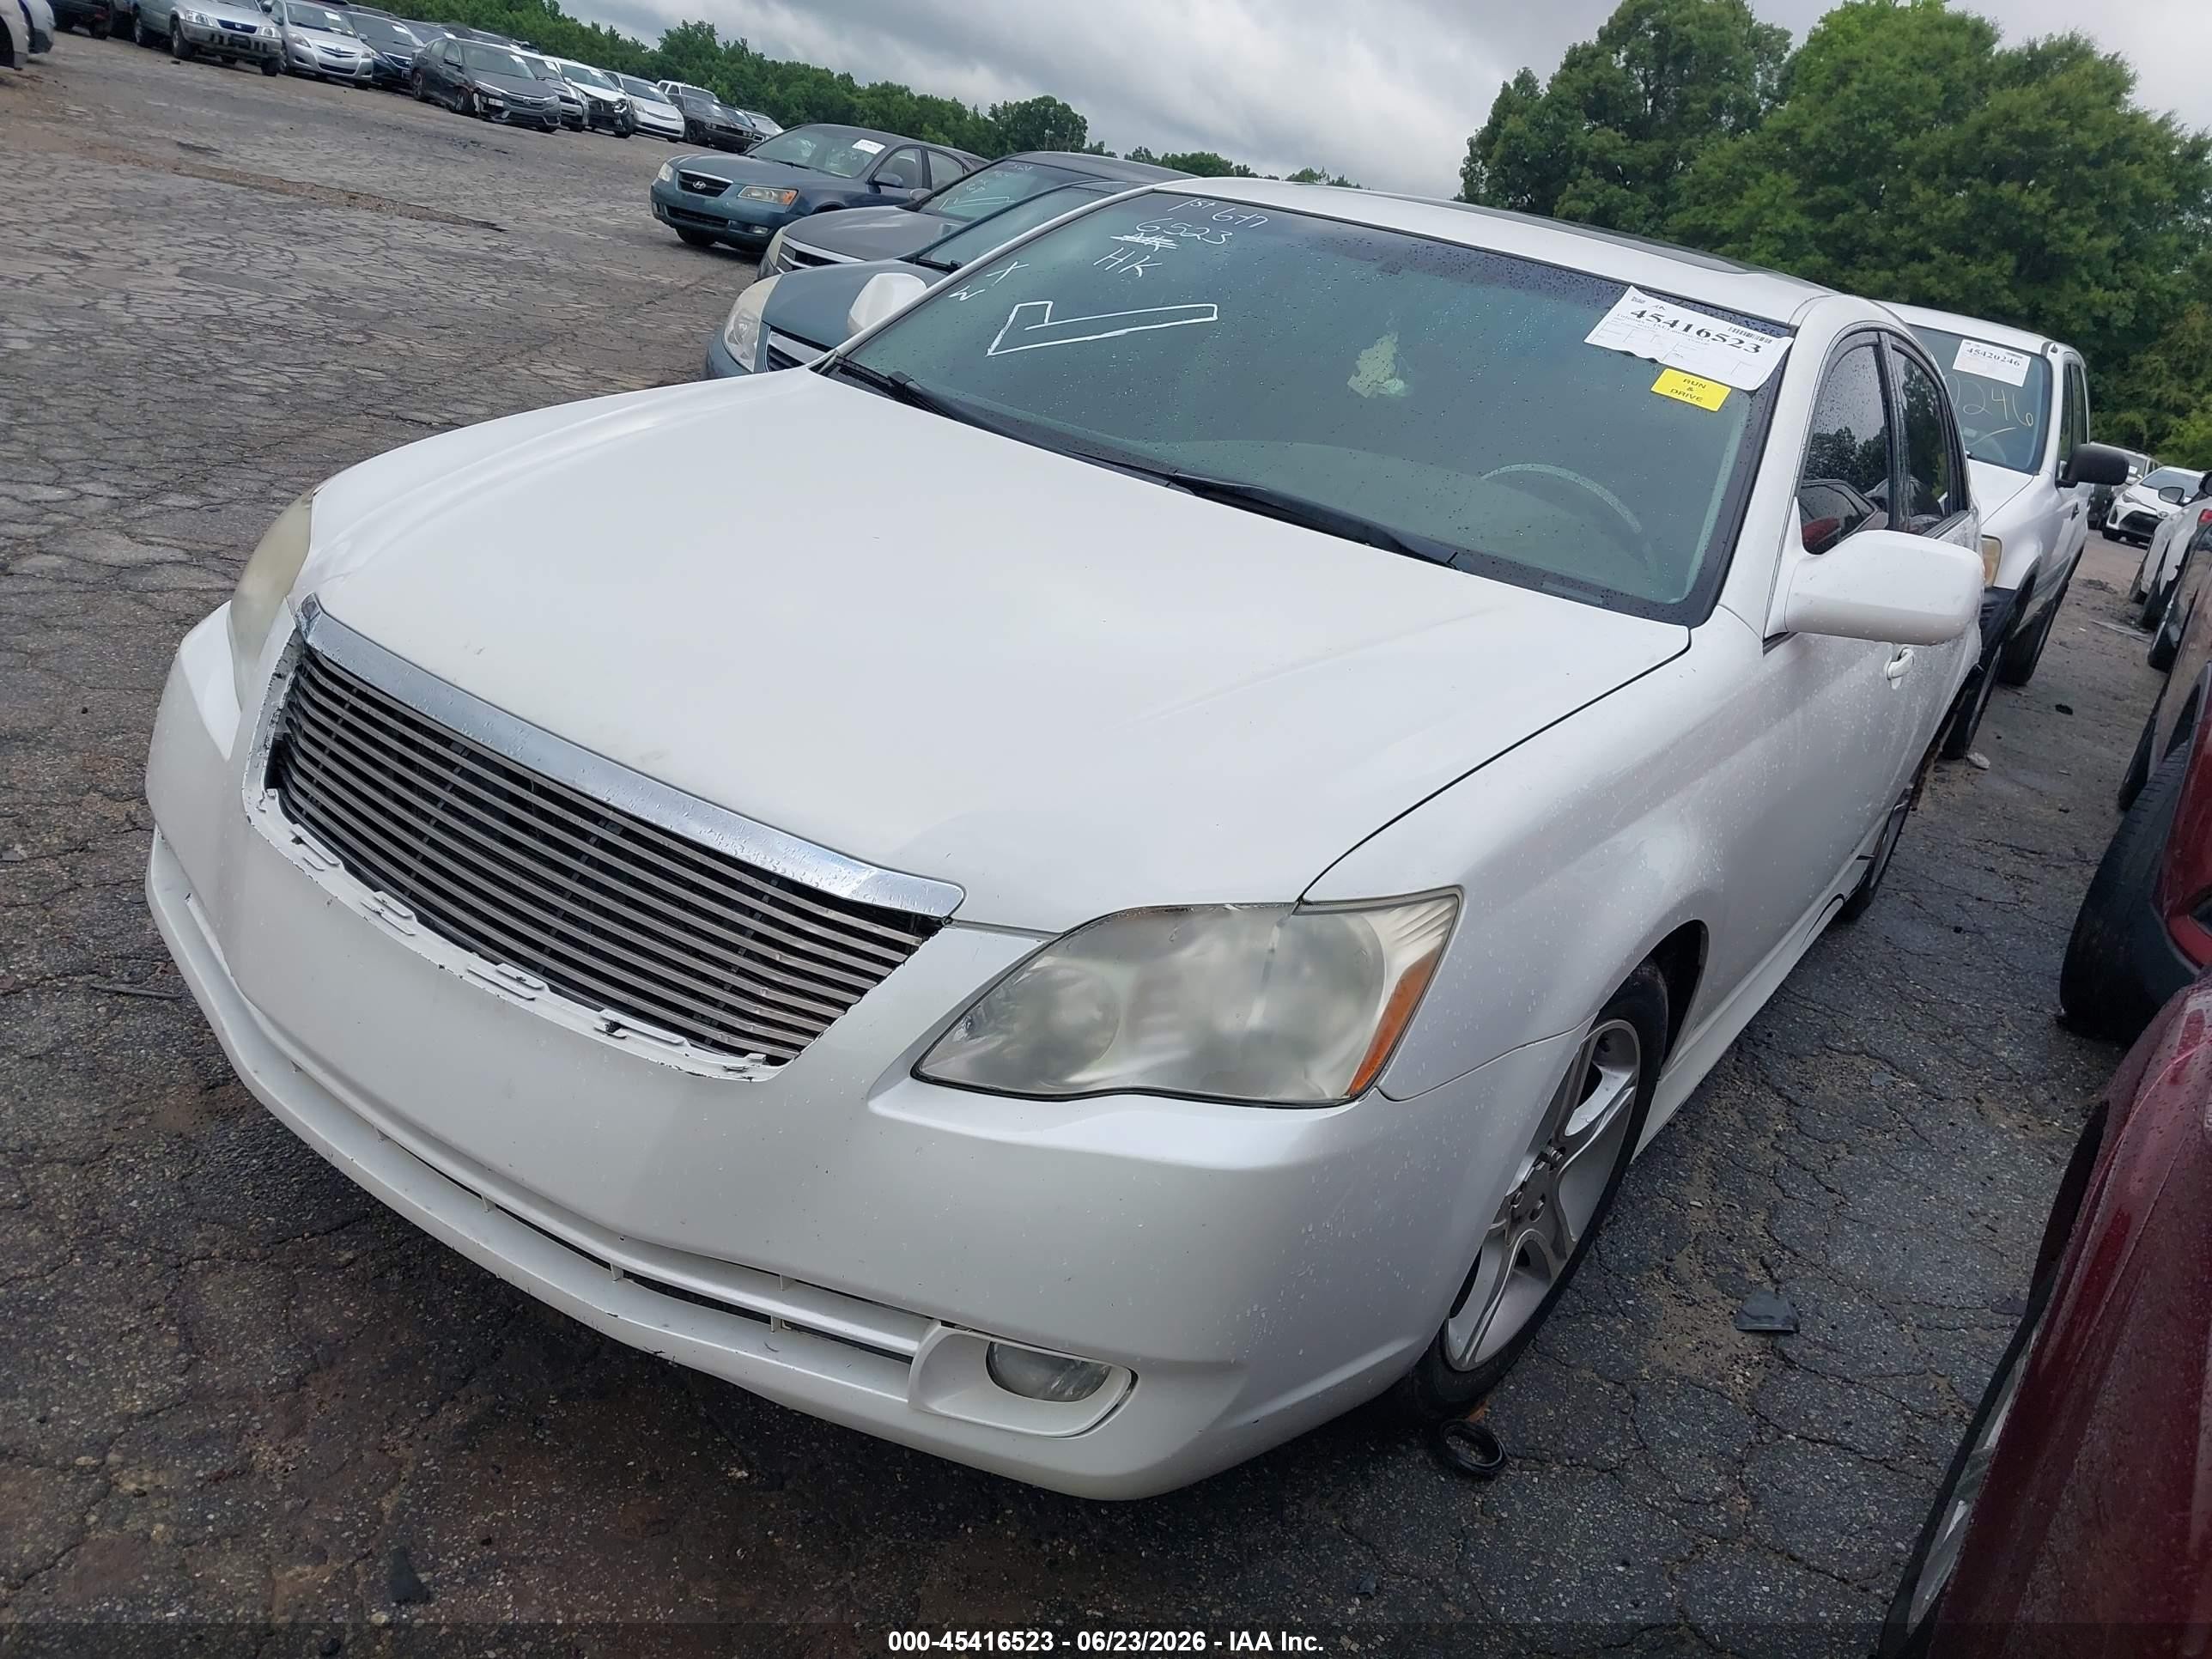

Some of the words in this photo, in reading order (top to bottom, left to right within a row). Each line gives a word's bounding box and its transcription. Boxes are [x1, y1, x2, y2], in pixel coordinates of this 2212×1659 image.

[1135, 217, 1234, 245] 6523
[1093, 246, 1164, 277] HK
[1630, 309, 1763, 355] 45416523
[1669, 388, 1705, 403] DRIVE
[1683, 378, 1707, 390] RUN
